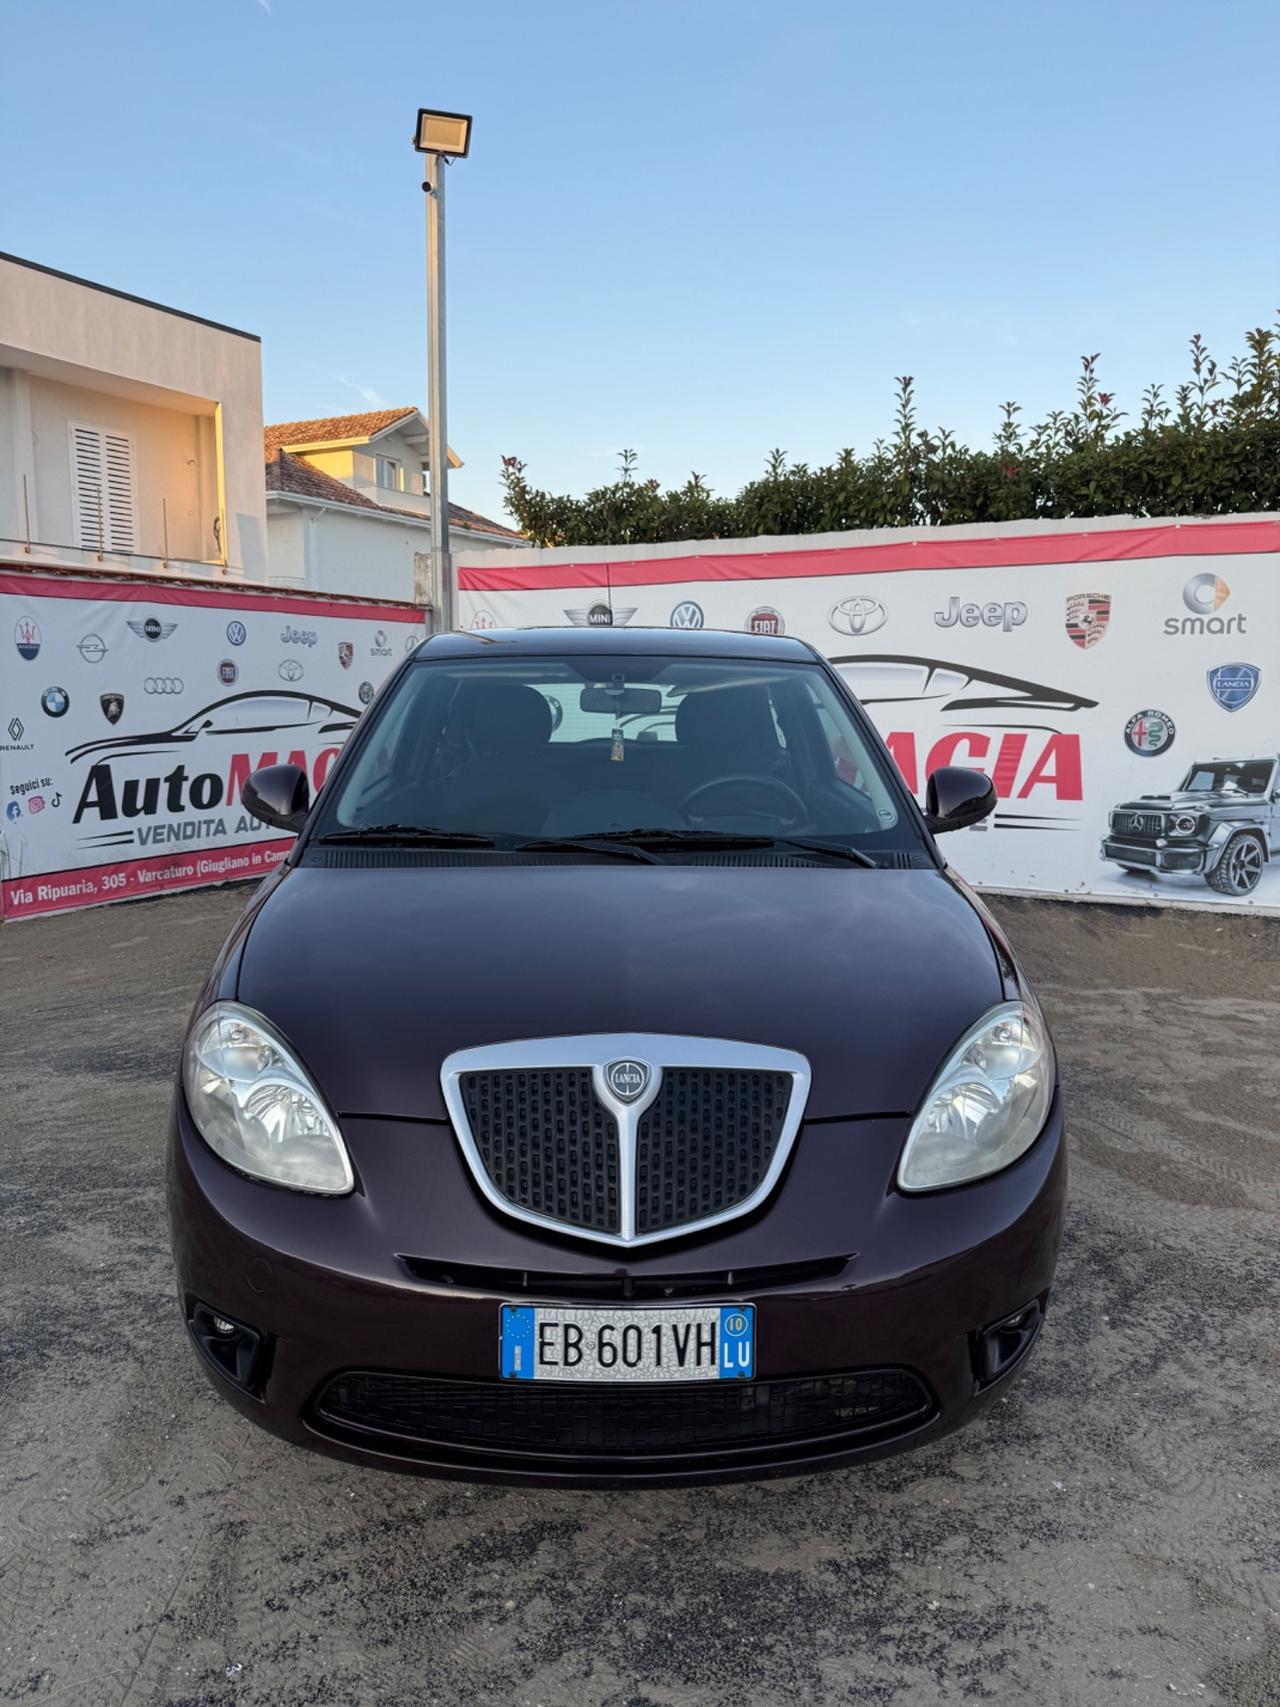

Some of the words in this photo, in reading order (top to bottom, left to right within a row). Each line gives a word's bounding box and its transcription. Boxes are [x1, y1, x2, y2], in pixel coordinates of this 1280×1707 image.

[934, 596, 1028, 632] Jeep
[1163, 613, 1248, 636] smart
[280, 625, 318, 648] Jeep
[1216, 680, 1251, 689] LANCIA
[136, 818, 227, 846] VENDITA
[234, 815, 270, 834] AU
[10, 889, 33, 905] Via
[37, 879, 98, 901] Ripuaria,
[101, 872, 127, 890] 305
[137, 866, 194, 883] Varcaturo
[197, 857, 249, 878] (Giugliano
[252, 853, 262, 865] in
[614, 1073, 641, 1083] LANCIA
[723, 1340, 751, 1369] LU
